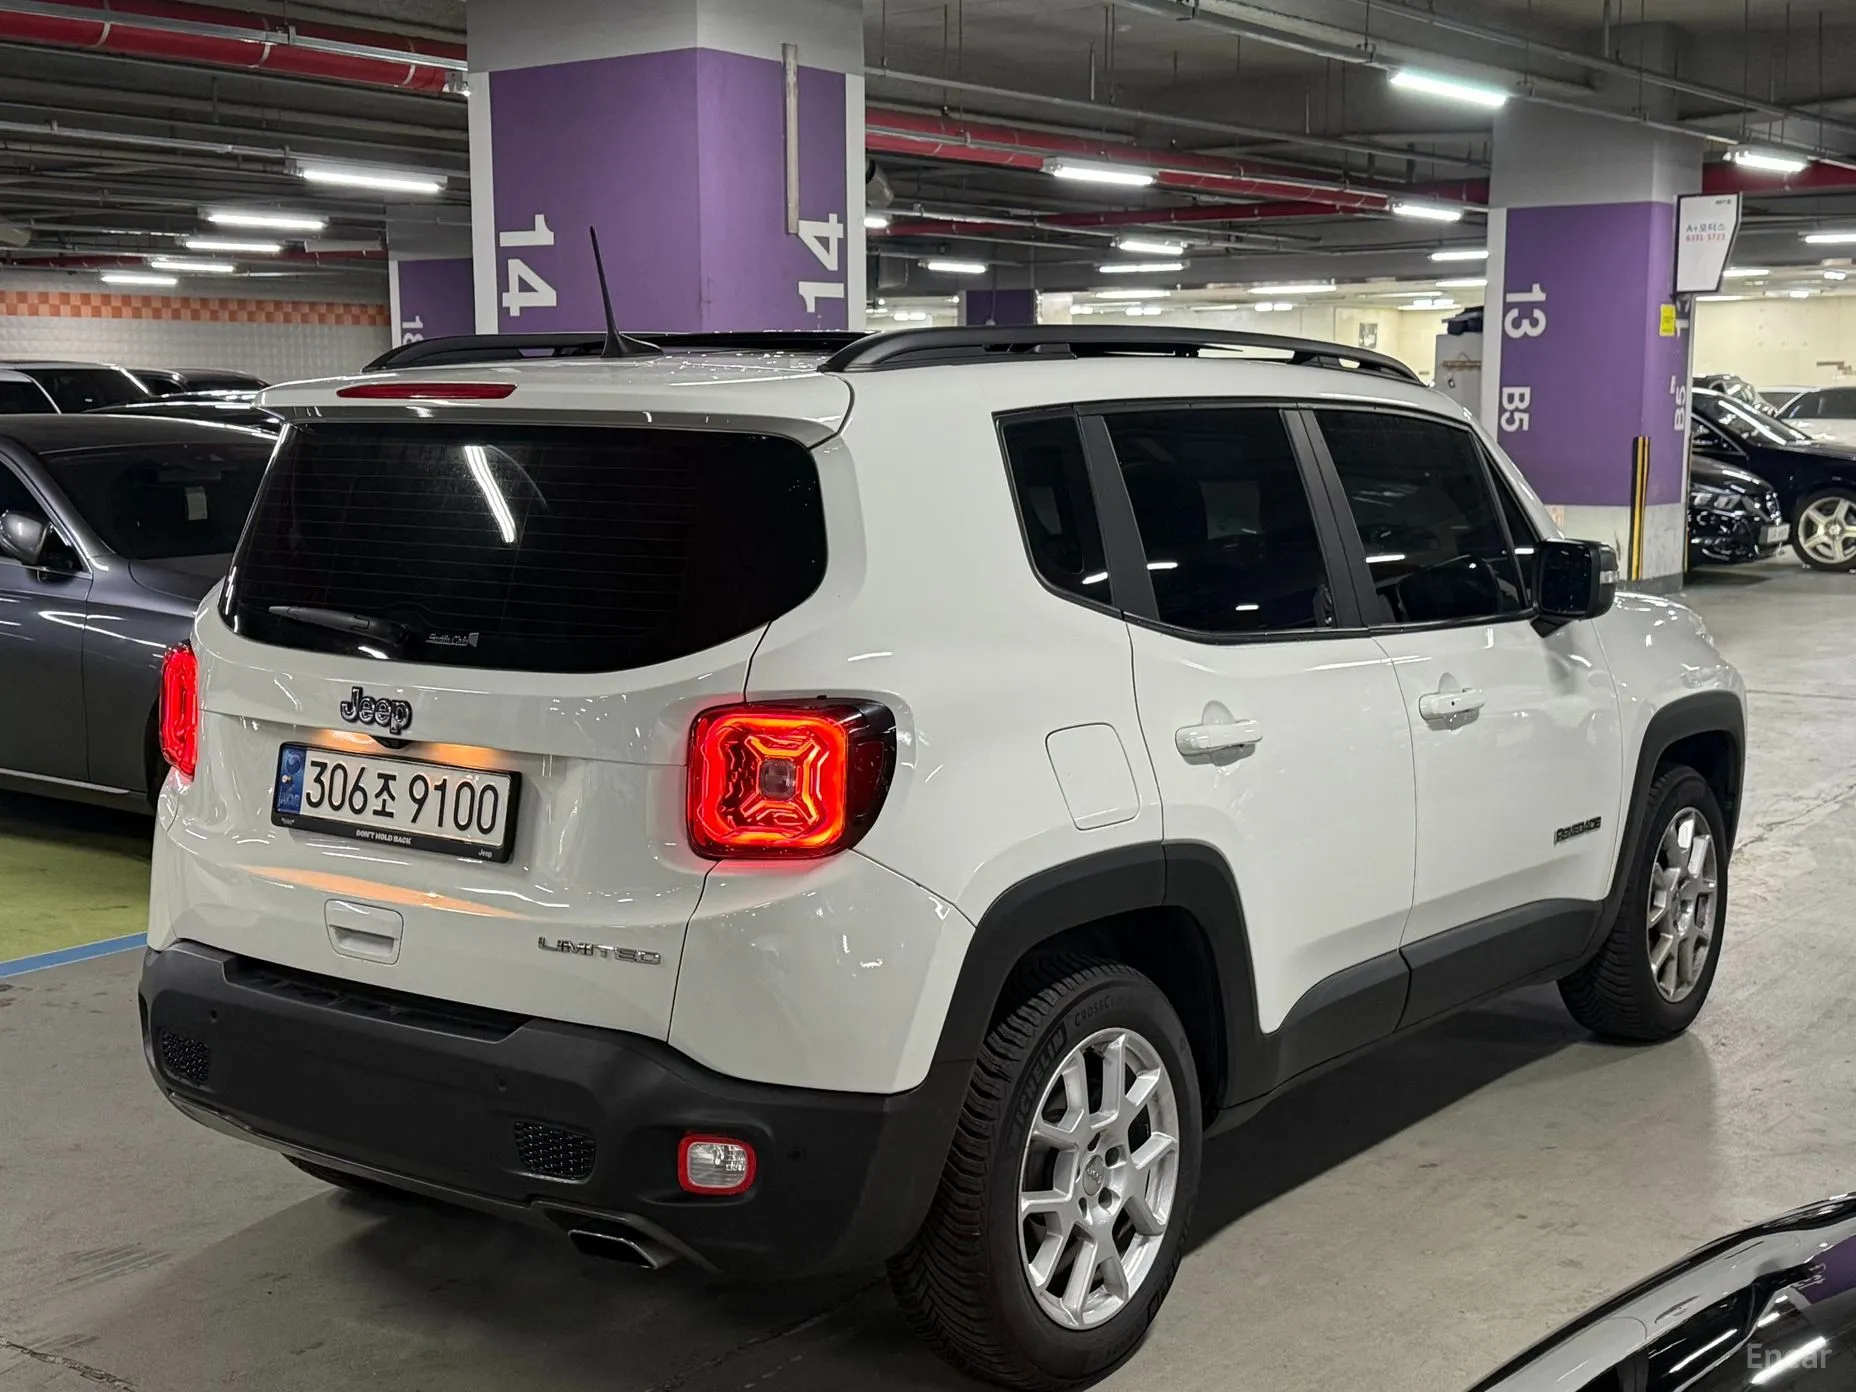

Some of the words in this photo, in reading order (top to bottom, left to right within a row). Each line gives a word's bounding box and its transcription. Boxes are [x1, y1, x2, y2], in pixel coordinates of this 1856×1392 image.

[499, 214, 557, 316] 14
[798, 213, 844, 312] 14
[1504, 283, 1546, 338] 13
[1500, 386, 1531, 432] B5
[1674, 385, 1686, 431] B5
[340, 686, 412, 735] Jeep
[306, 760, 397, 818] 306조
[409, 774, 499, 834] 9100
[356, 830, 375, 839] DON'T
[375, 832, 393, 842] HOLD
[393, 835, 412, 845] BACK
[478, 848, 493, 859] Jeep
[538, 936, 661, 965] LIMITED
